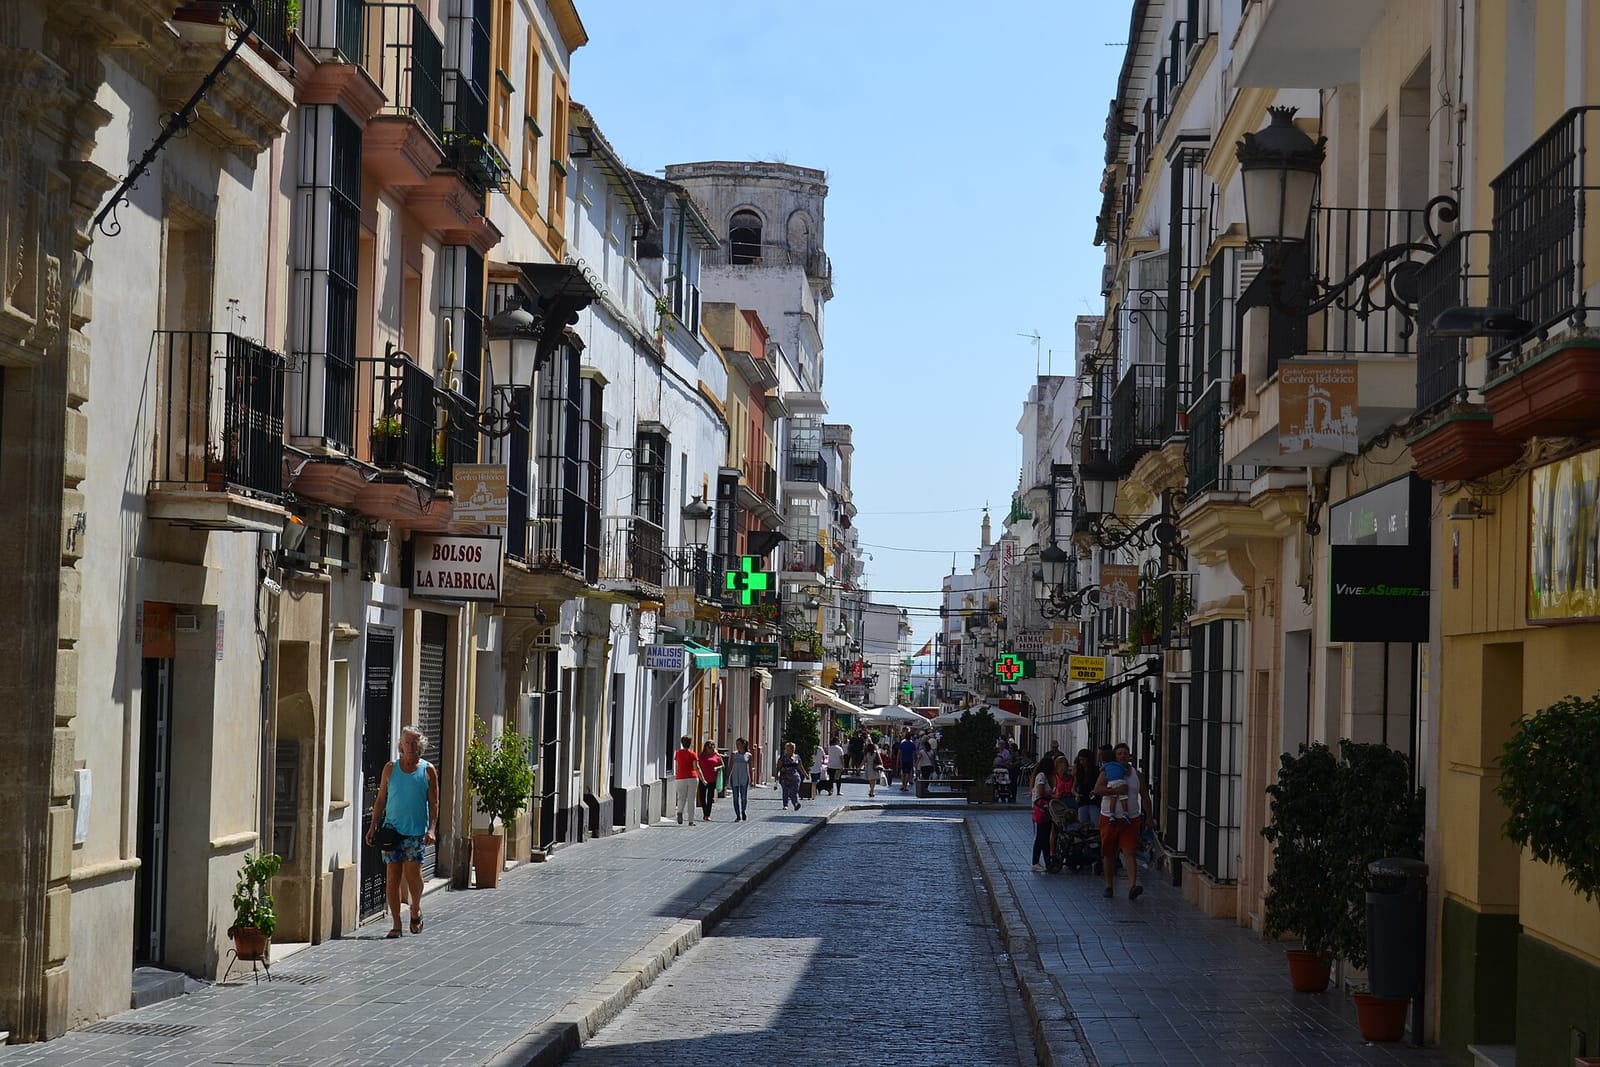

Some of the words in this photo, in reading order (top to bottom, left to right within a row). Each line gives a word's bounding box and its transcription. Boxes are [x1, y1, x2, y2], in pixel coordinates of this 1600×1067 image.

[1281, 373, 1314, 384] Centro
[1316, 372, 1355, 384] Histórico
[432, 543, 482, 563] BOLSOS
[416, 570, 434, 588] LA
[438, 571, 496, 591] FABRICA
[647, 647, 682, 658] ANALISIS
[646, 657, 682, 669] CLINICOS
[1078, 670, 1097, 678] ORO
